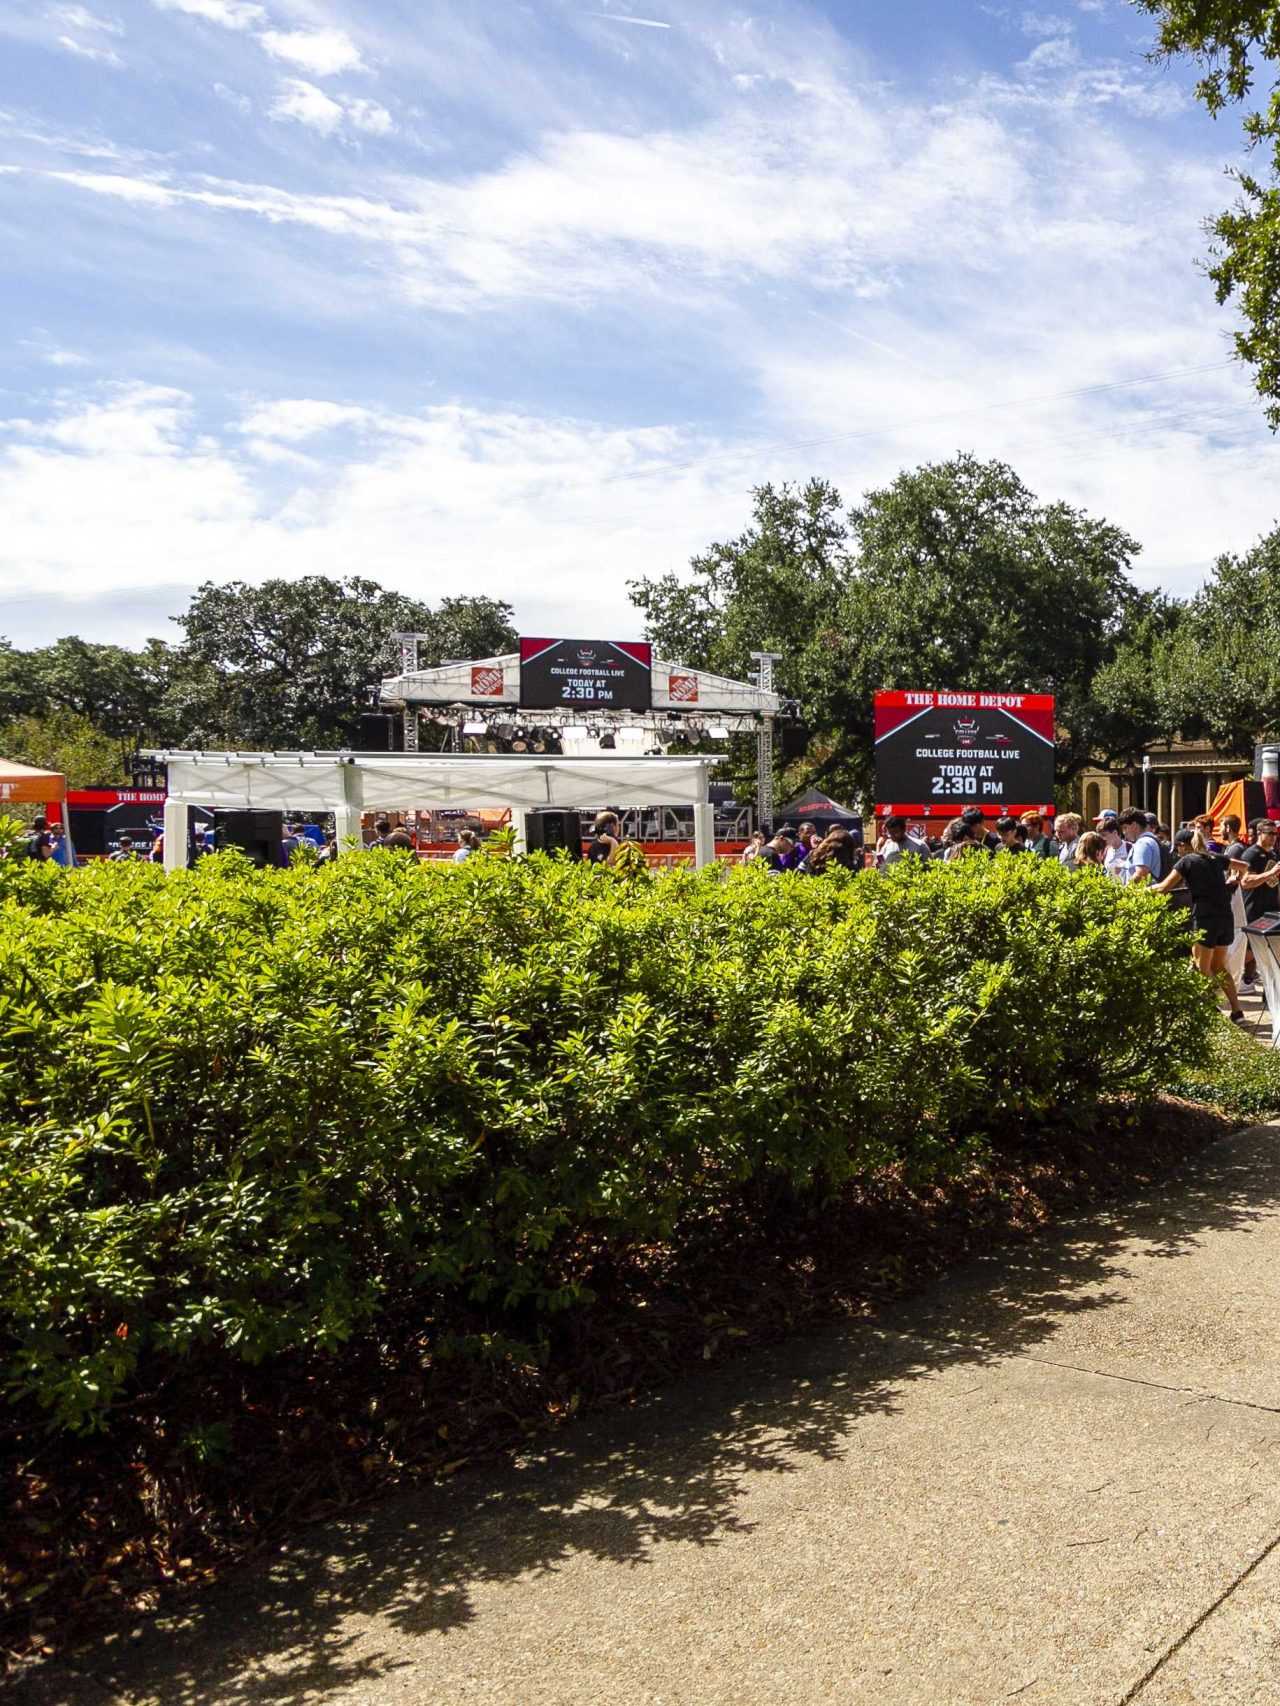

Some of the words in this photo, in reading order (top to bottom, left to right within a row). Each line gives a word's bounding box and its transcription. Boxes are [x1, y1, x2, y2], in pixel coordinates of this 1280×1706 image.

[568, 679, 594, 687] TODAY
[562, 687, 595, 699] 2:30
[598, 691, 613, 699] PM
[905, 694, 933, 704] THE
[937, 695, 976, 706] HOME
[979, 696, 1026, 707] DEPOT
[916, 749, 954, 758] COLLEGE
[956, 749, 999, 759] FOOTBALL
[1001, 750, 1020, 759] LIVE
[939, 765, 976, 776] TODAY
[980, 765, 994, 776] AT
[932, 777, 976, 794] 2:30
[983, 782, 1003, 794] PM
